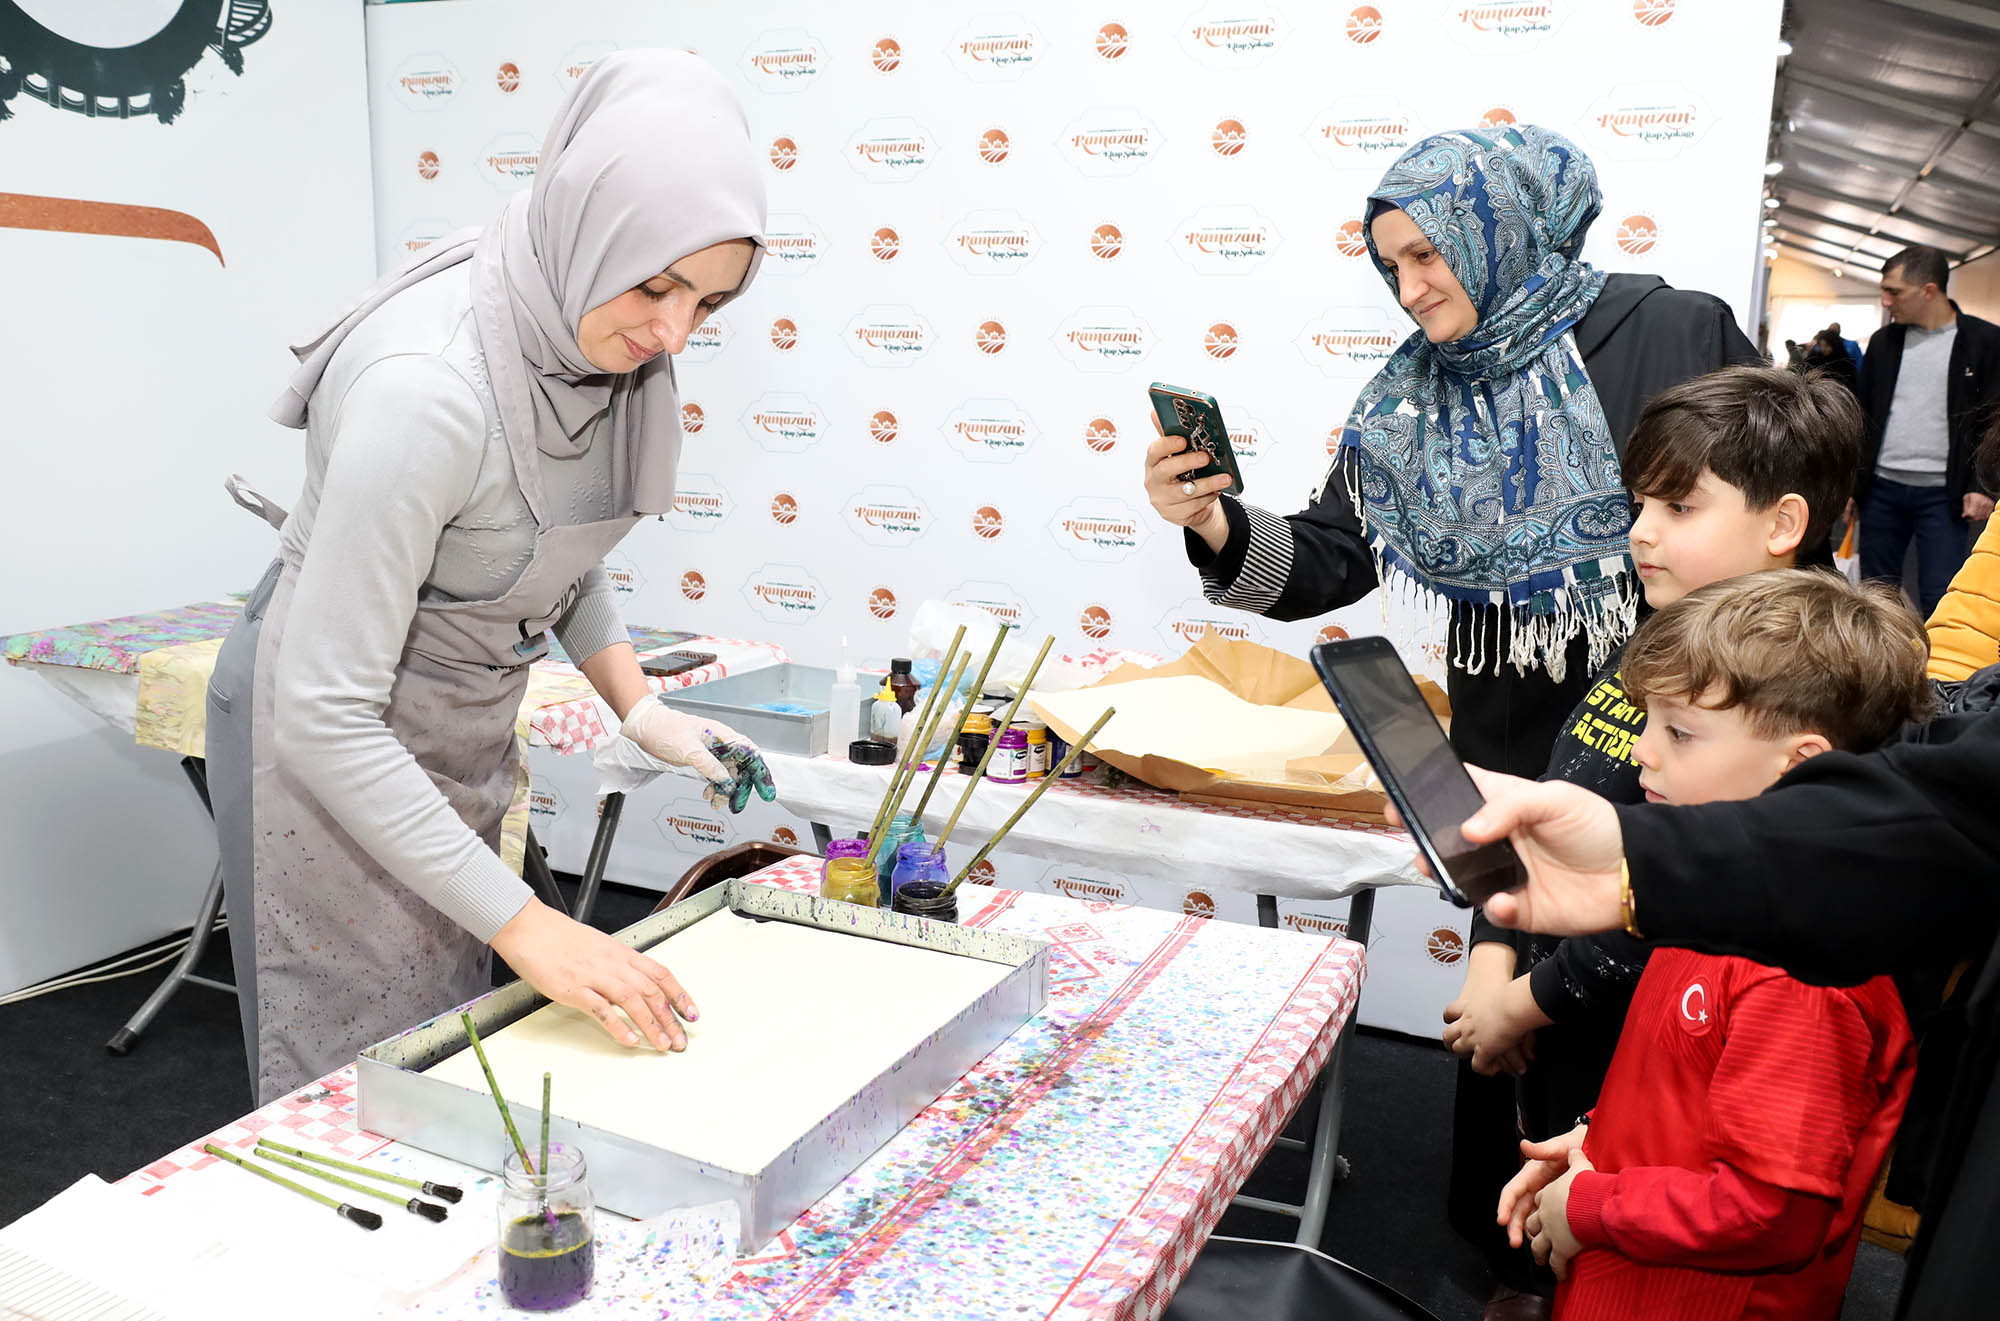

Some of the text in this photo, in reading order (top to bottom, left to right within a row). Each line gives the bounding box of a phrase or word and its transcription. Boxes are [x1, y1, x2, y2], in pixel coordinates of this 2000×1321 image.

[1458, 1, 1552, 32] Ramazan
[1192, 18, 1274, 48] Ramazan
[960, 33, 1033, 62] Ramazan
[751, 47, 817, 75] Ramazan
[1321, 117, 1409, 147] Ramazan
[1597, 105, 1697, 137] Ramazan
[856, 137, 925, 163] Ramazan
[1071, 128, 1148, 156] Ramazan
[764, 233, 817, 257] amazan
[956, 232, 1029, 257] Ramazan
[1185, 227, 1266, 254] Ramazan
[855, 325, 924, 348] Ramazan
[1066, 327, 1142, 352] Ramazan
[1311, 329, 1397, 356] Ramazan
[752, 412, 817, 433] Ramazan
[954, 419, 1025, 444] Ramazan
[672, 494, 723, 513] amazan
[854, 506, 921, 527] Ramazan
[1061, 519, 1137, 542] Ramazan
[1283, 913, 1349, 933] Ramaza
